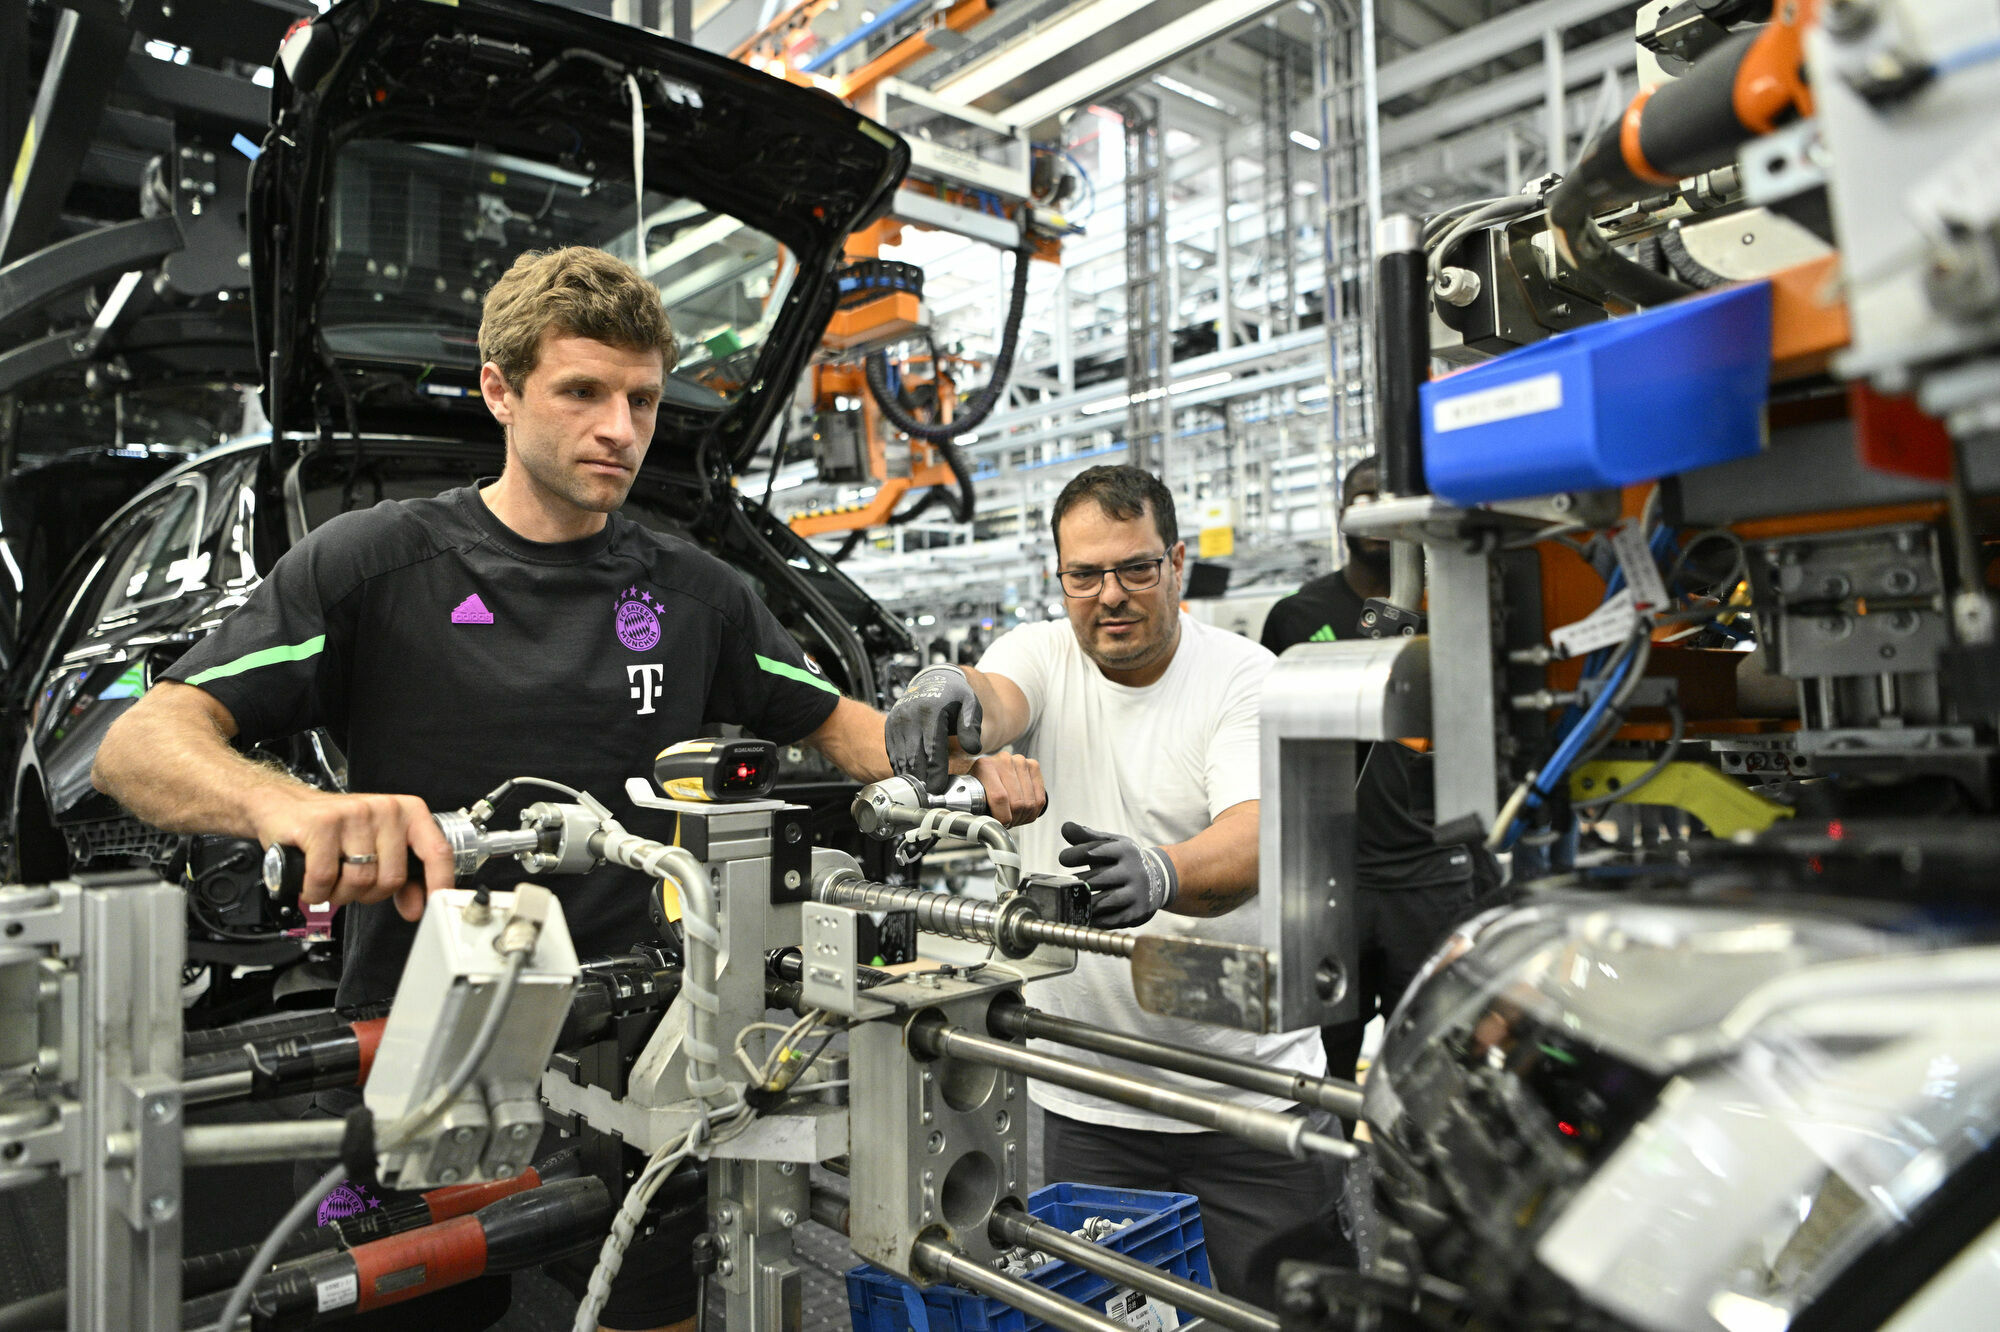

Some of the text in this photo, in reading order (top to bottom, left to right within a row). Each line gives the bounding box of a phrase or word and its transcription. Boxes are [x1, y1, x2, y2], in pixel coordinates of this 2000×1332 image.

[455, 611, 492, 623] adidas
[625, 604, 655, 624] BAYERN
[626, 663, 664, 715] T
[335, 1188, 361, 1213] BAYERN
